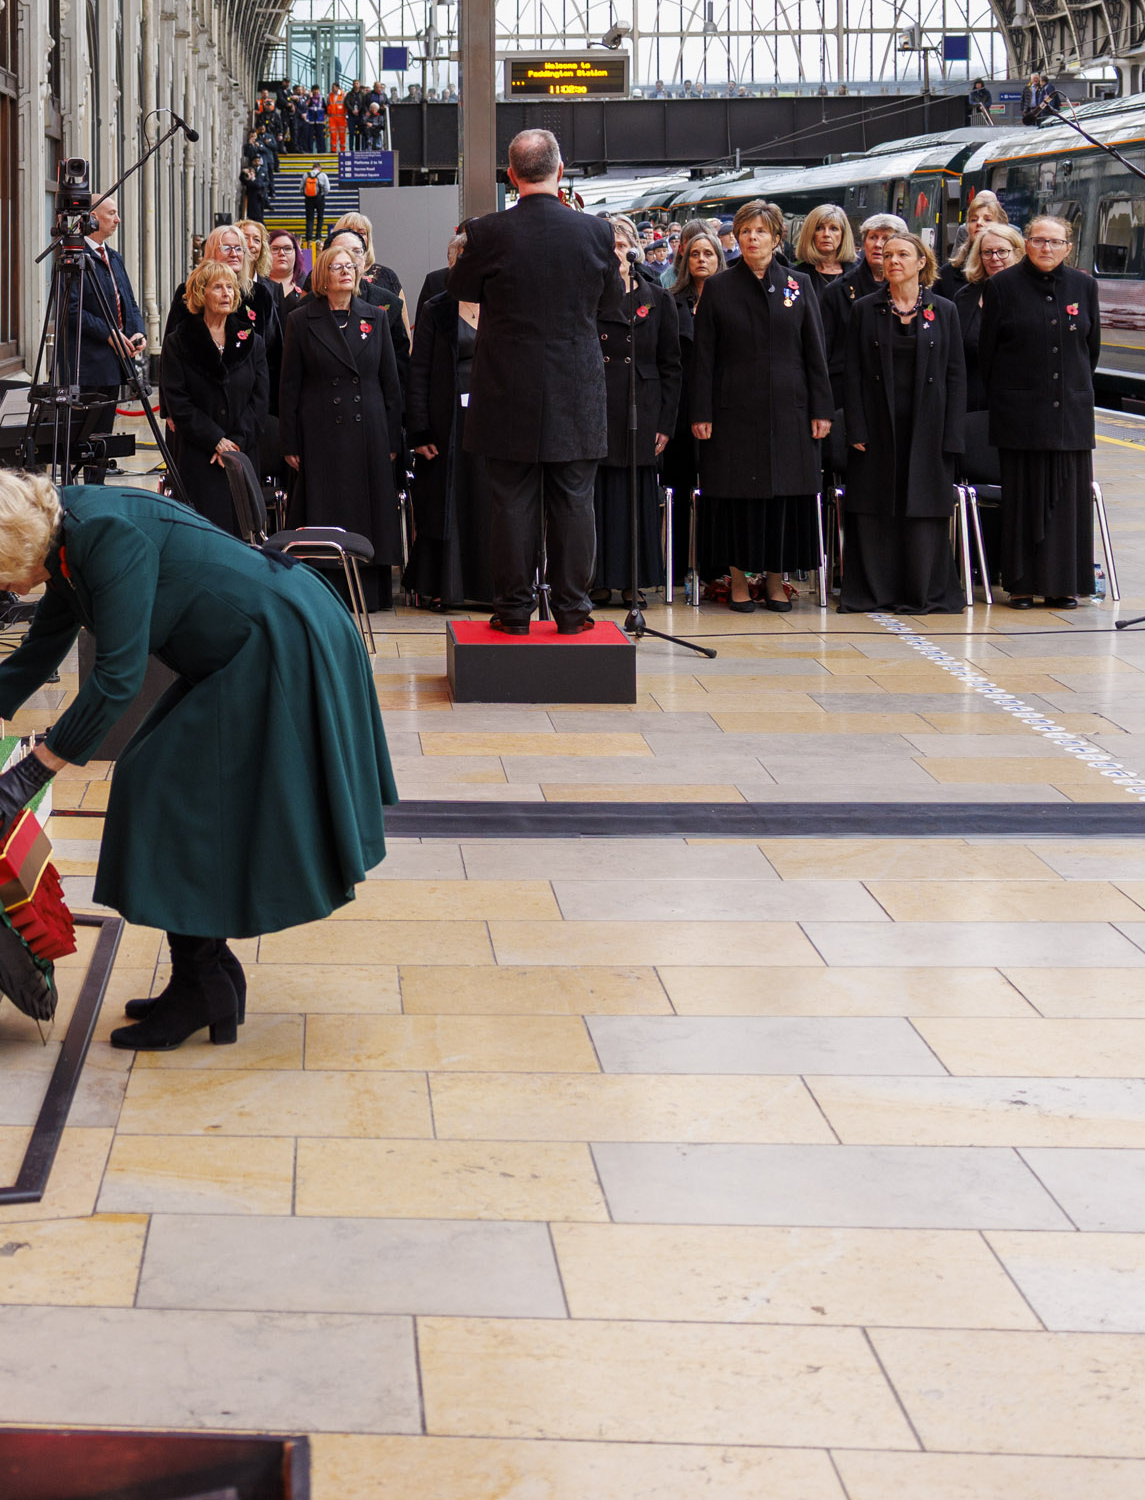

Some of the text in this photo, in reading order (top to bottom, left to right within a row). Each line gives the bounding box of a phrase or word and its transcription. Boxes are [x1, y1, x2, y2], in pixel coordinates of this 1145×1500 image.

[544, 61, 591, 70] Welcome to
[527, 69, 608, 78] Paddington Station
